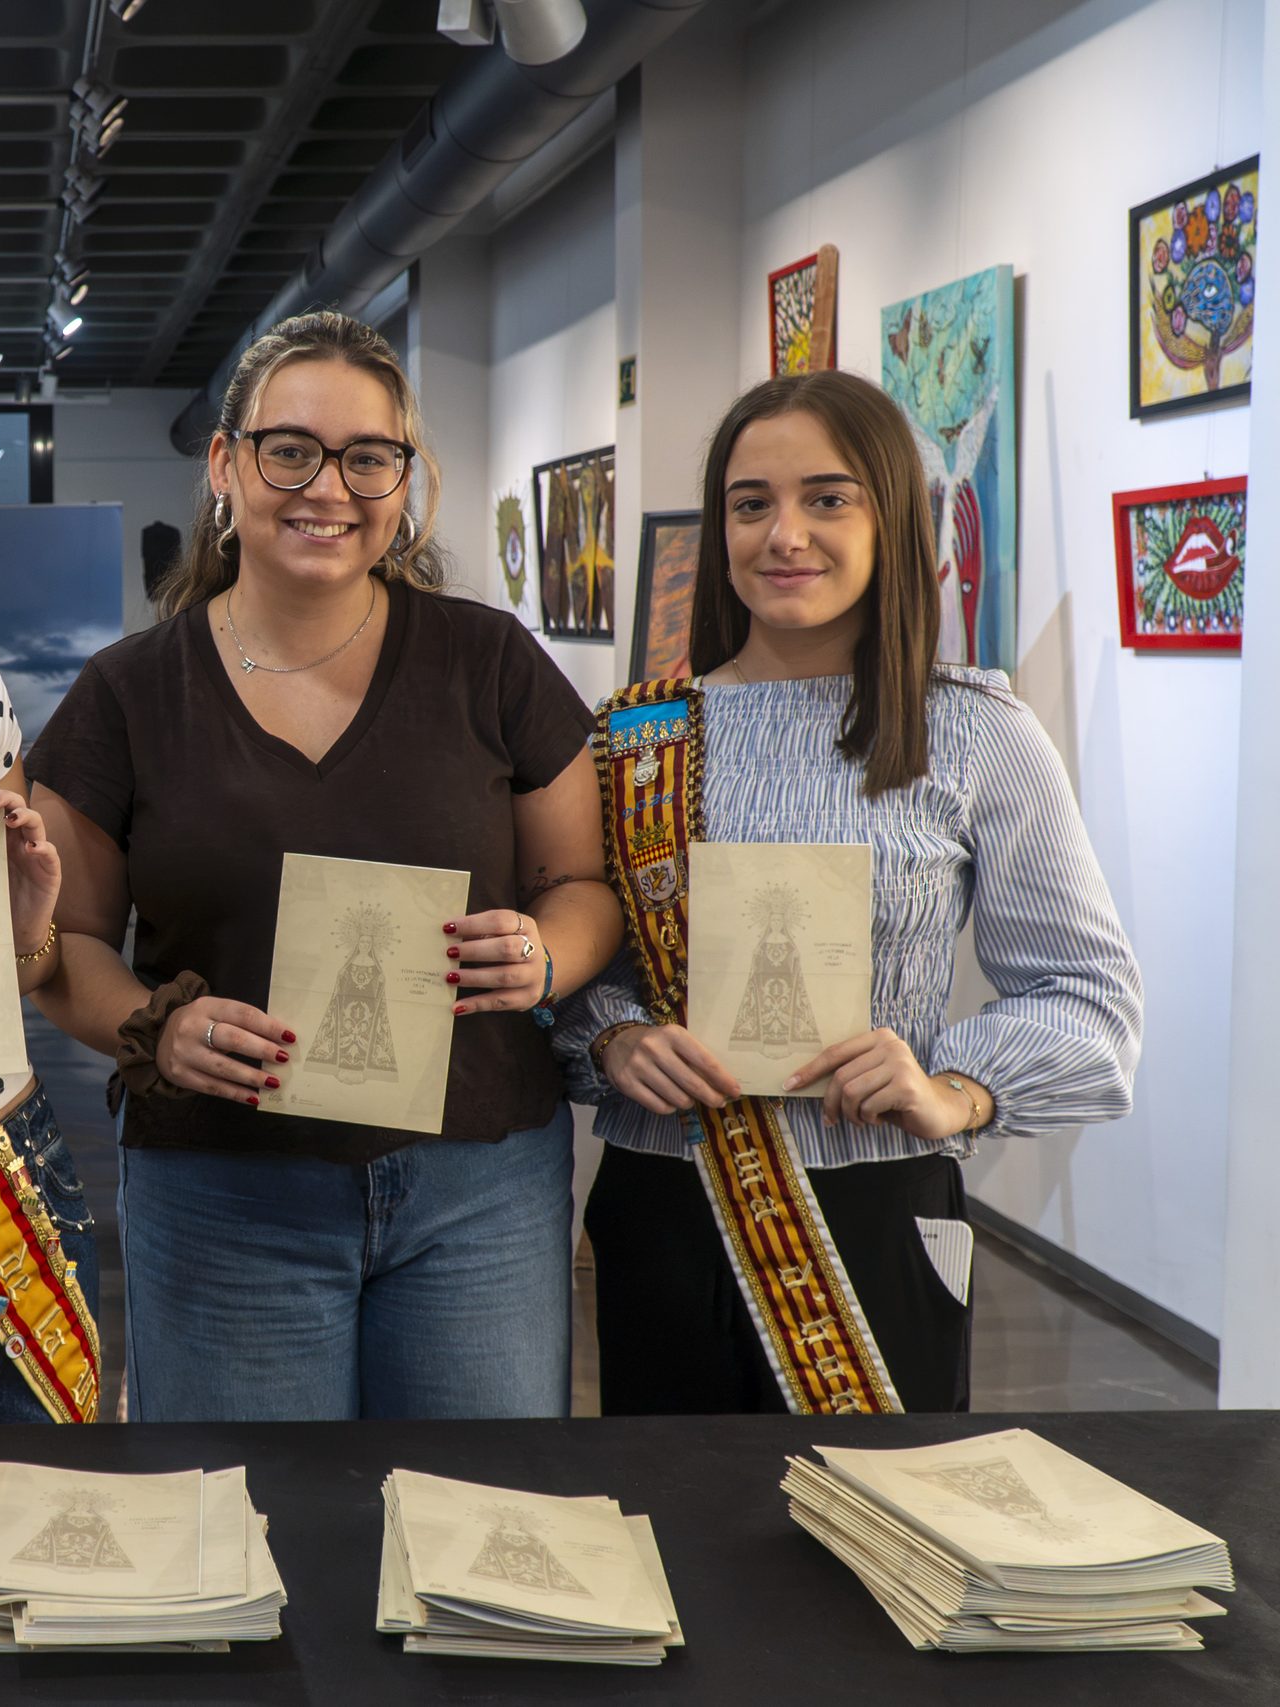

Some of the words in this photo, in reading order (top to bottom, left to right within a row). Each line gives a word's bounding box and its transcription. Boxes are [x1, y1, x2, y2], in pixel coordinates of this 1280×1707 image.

[622, 792, 675, 821] 2026
[723, 1113, 780, 1223] ama
[34, 1305, 66, 1362] la
